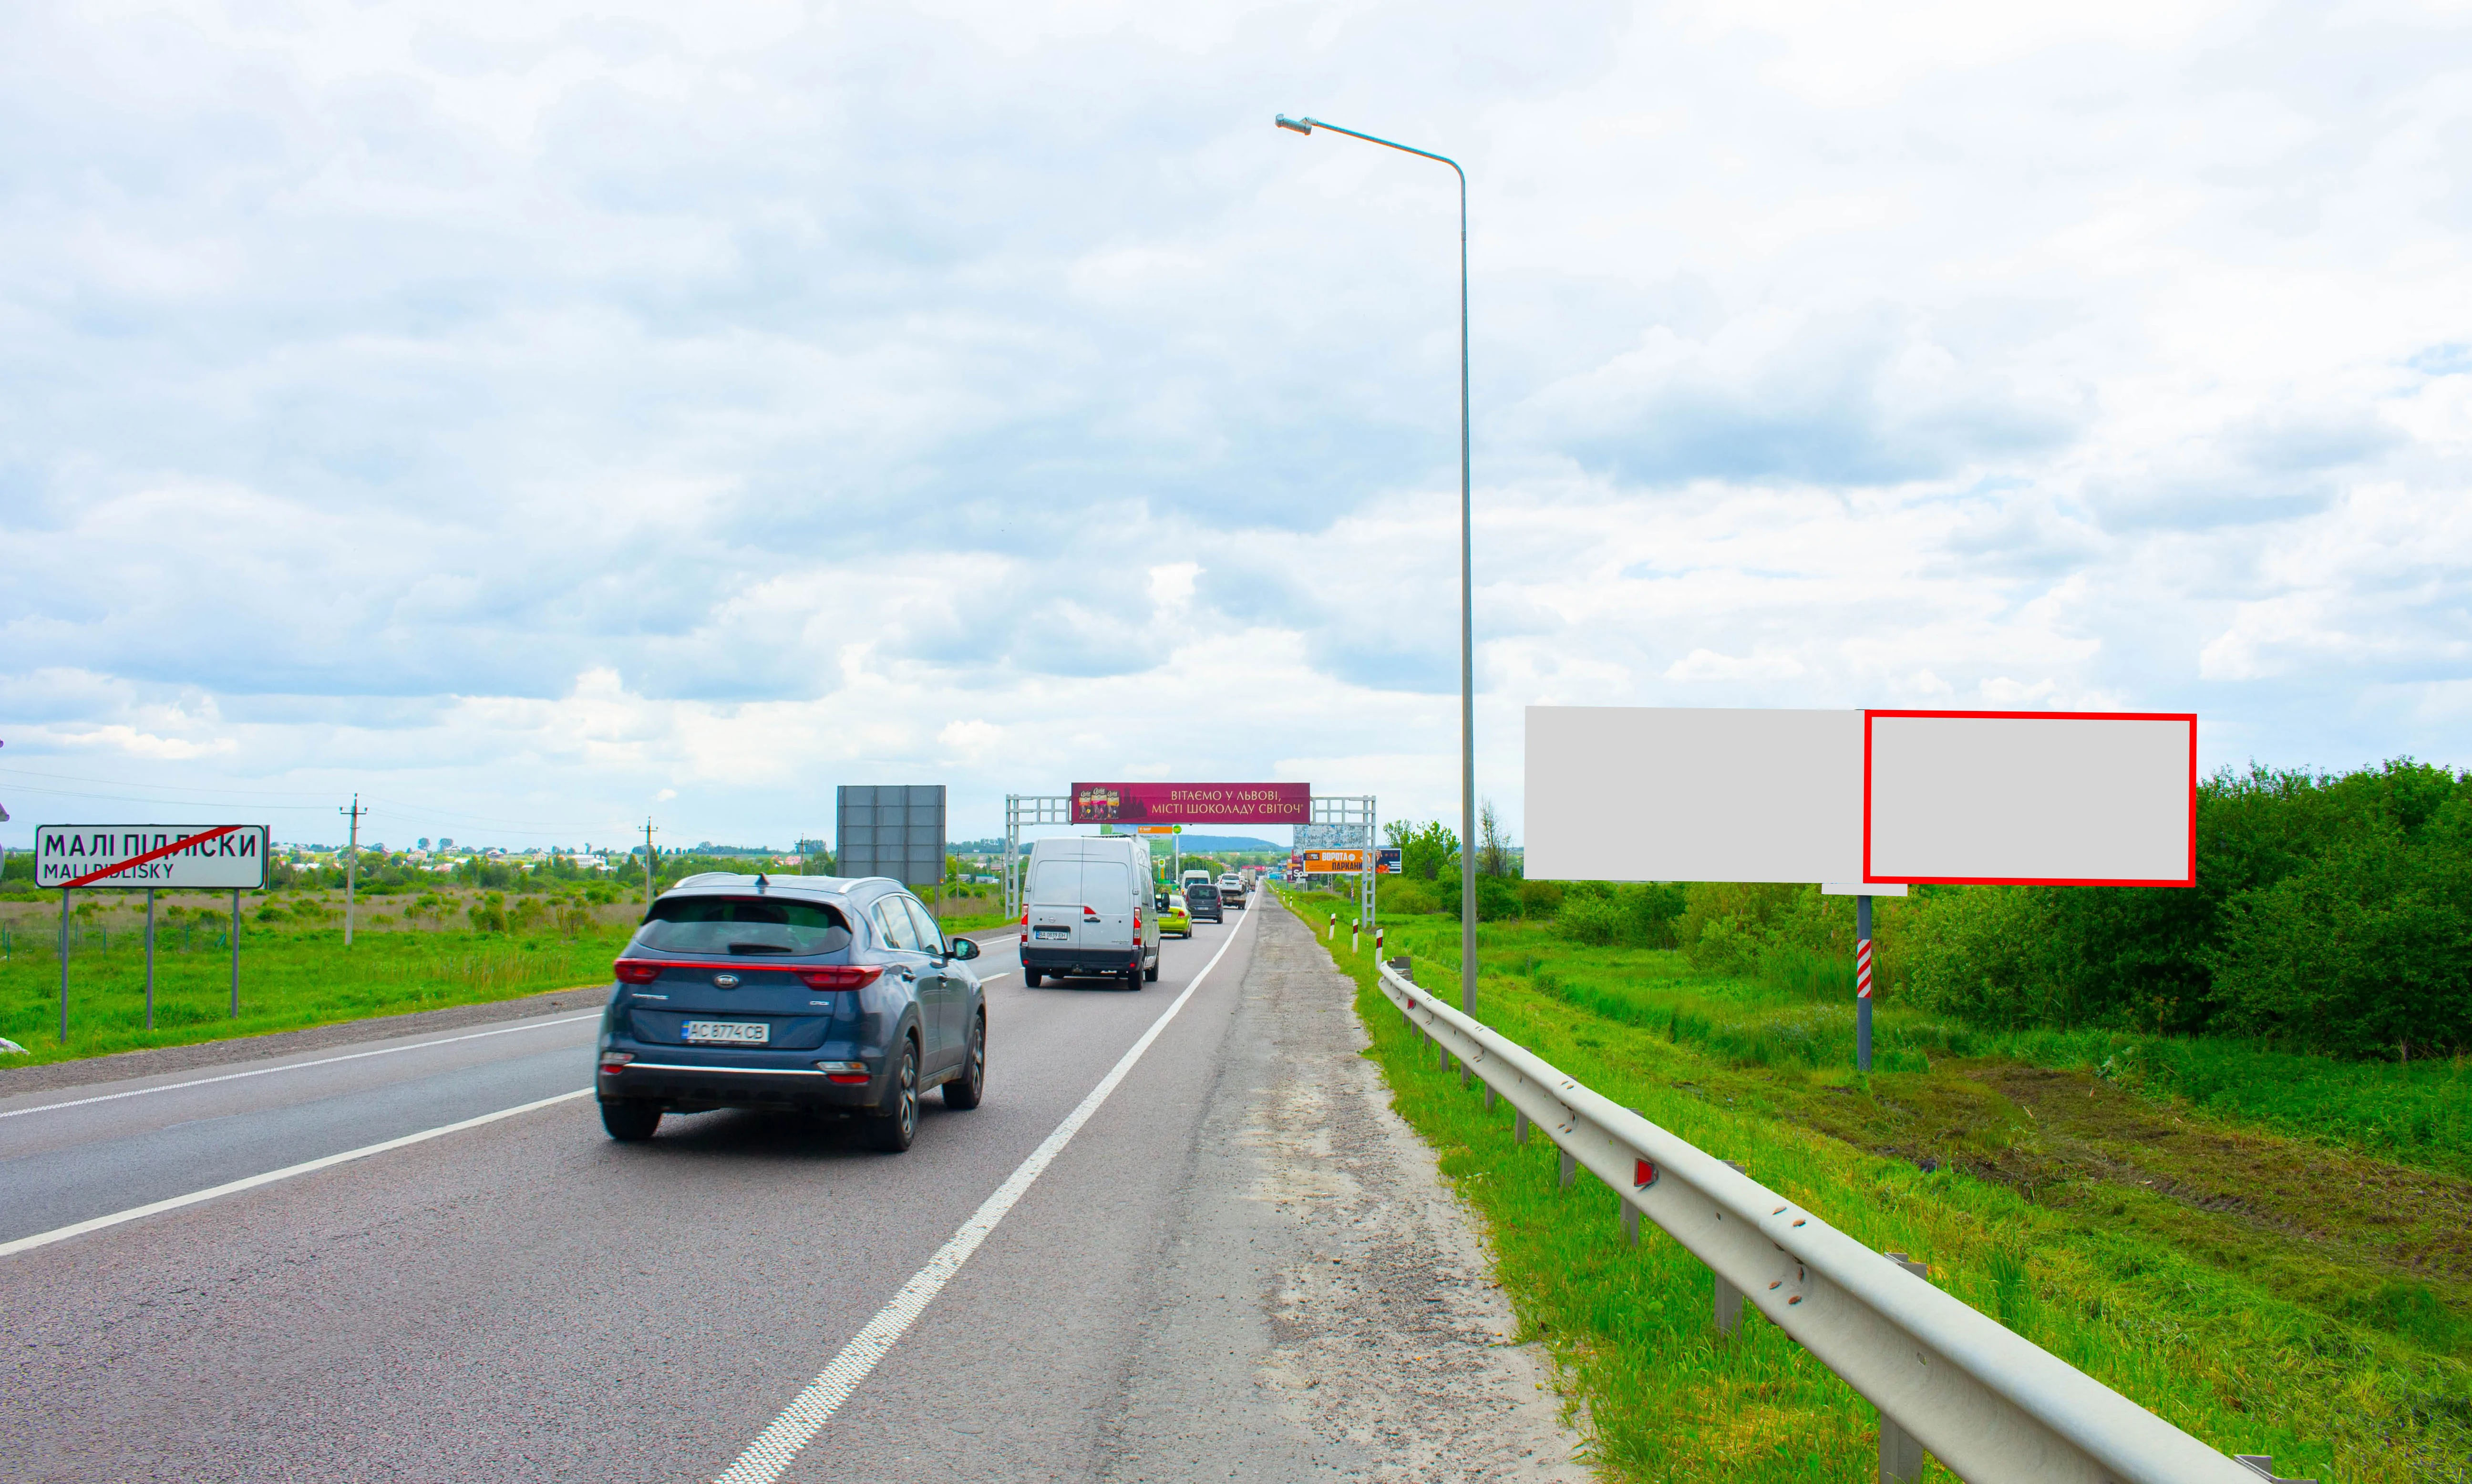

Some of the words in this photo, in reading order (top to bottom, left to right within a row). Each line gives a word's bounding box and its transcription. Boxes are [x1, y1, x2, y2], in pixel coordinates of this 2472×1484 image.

[1171, 790, 1222, 801] ВІТАЄМО
[1226, 791, 1233, 801] У
[1236, 791, 1281, 802] ЛЬВОВІ,
[1152, 804, 1183, 814] МІСТІ
[1187, 804, 1255, 815] ШОКОЛАДУ
[45, 835, 114, 856] МАЛІ
[1322, 852, 1348, 861] ВОРОТА
[44, 864, 88, 878] MALI
[1332, 862, 1362, 870] ПАРКАНИ
[690, 1024, 709, 1037] AC
[746, 1026, 763, 1039] CB
